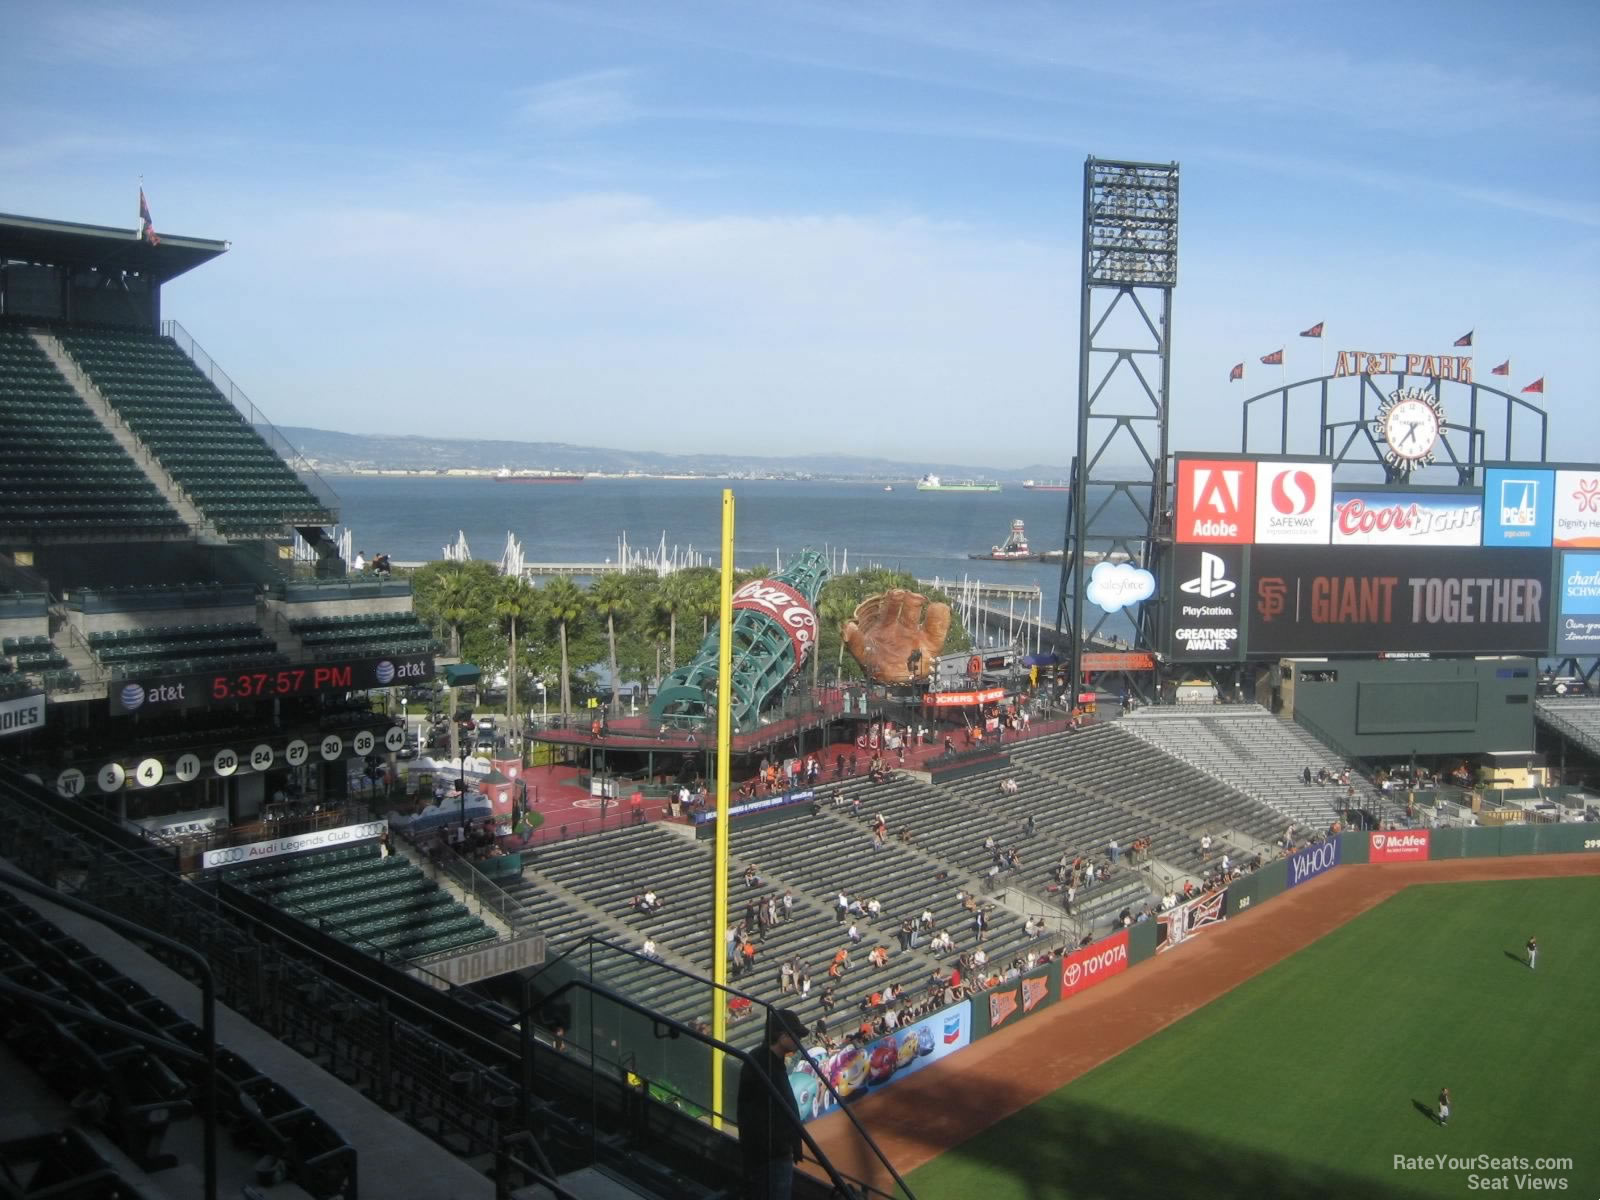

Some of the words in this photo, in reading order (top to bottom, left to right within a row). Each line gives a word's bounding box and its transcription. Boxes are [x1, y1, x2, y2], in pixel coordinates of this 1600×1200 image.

[1334, 350, 1397, 378] AT&T
[1406, 353, 1473, 384] PARK
[1375, 401, 1391, 433] SAN
[1391, 387, 1449, 435] FRANCISCO
[1385, 450, 1436, 471] GIANTS
[1269, 516, 1316, 528] SAFEWAY
[1337, 499, 1418, 536] Coors
[1409, 505, 1480, 536] LIGHT
[1503, 507, 1535, 525] PG&E
[1558, 518, 1587, 530] Dignity
[1193, 519, 1237, 537] Adobe
[1100, 577, 1145, 595] salesforce
[1311, 576, 1398, 624] GIANT
[1408, 577, 1543, 623] TOGETHER
[1182, 606, 1232, 618] PlayStation
[1175, 628, 1238, 641] GREATNESS
[149, 683, 185, 702] at&t
[213, 670, 305, 699] 5:37:57
[314, 666, 352, 689] PM
[397, 660, 426, 678] at&t
[388, 733, 403, 745] 44
[290, 746, 305, 759] 27
[324, 742, 339, 754] 30
[218, 756, 234, 769] 20
[254, 751, 270, 765] 24
[144, 766, 153, 779] 4
[182, 762, 193, 775] 11
[106, 772, 116, 785] 3
[249, 844, 277, 857] Audi
[280, 836, 325, 853] Legends
[327, 831, 350, 842] Club
[1386, 835, 1426, 847] McAfee
[1291, 839, 1337, 884] YAHOO!
[458, 940, 528, 981] DOLLAR
[1083, 944, 1127, 977] TOYOTA
